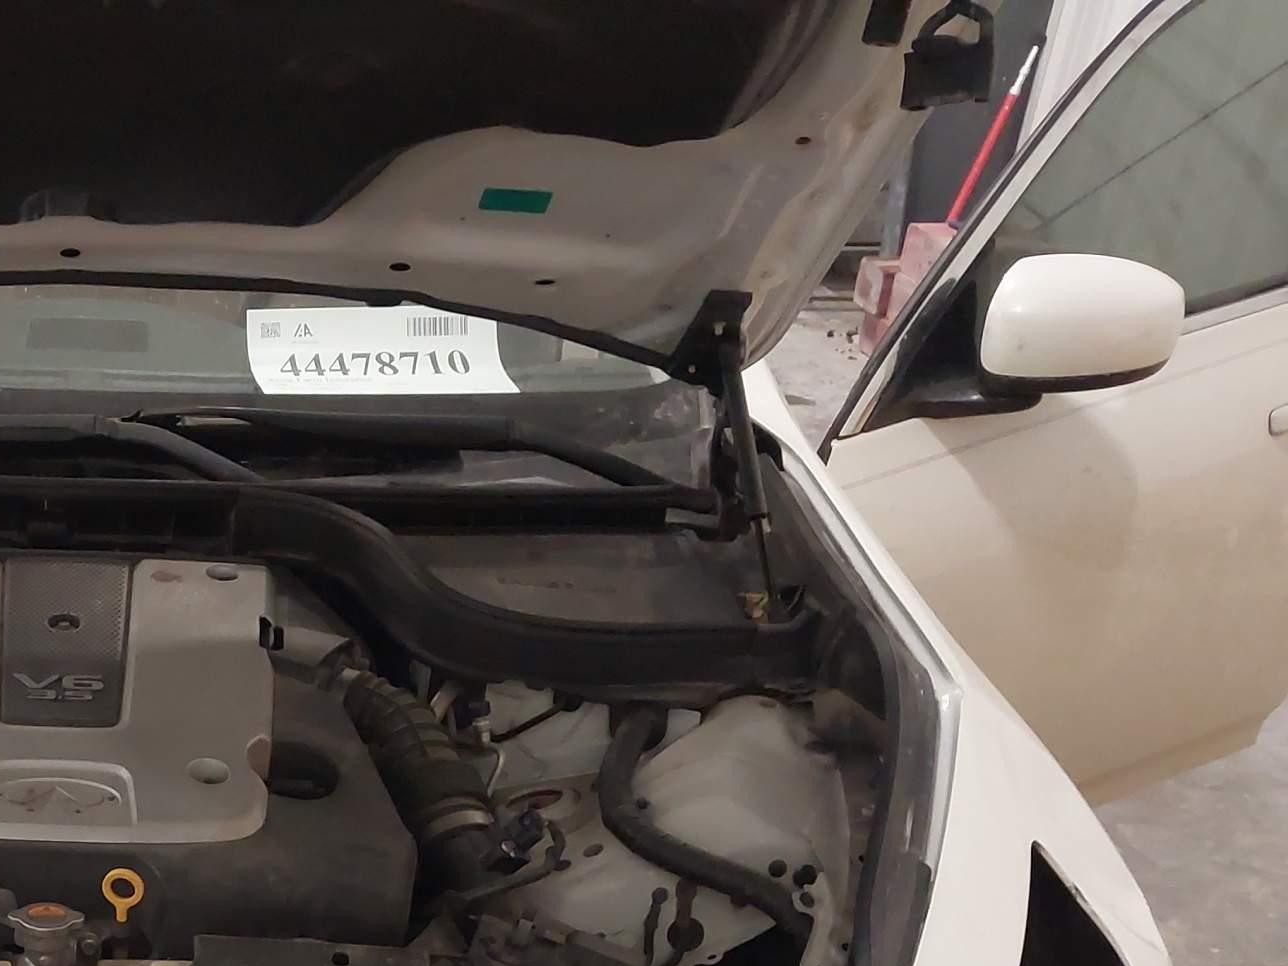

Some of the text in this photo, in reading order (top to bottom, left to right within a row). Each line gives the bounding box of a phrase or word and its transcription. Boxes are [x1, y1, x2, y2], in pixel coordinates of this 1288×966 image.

[280, 349, 470, 376] 44478710
[13, 673, 104, 690] V6
[25, 689, 92, 700] 3.5
